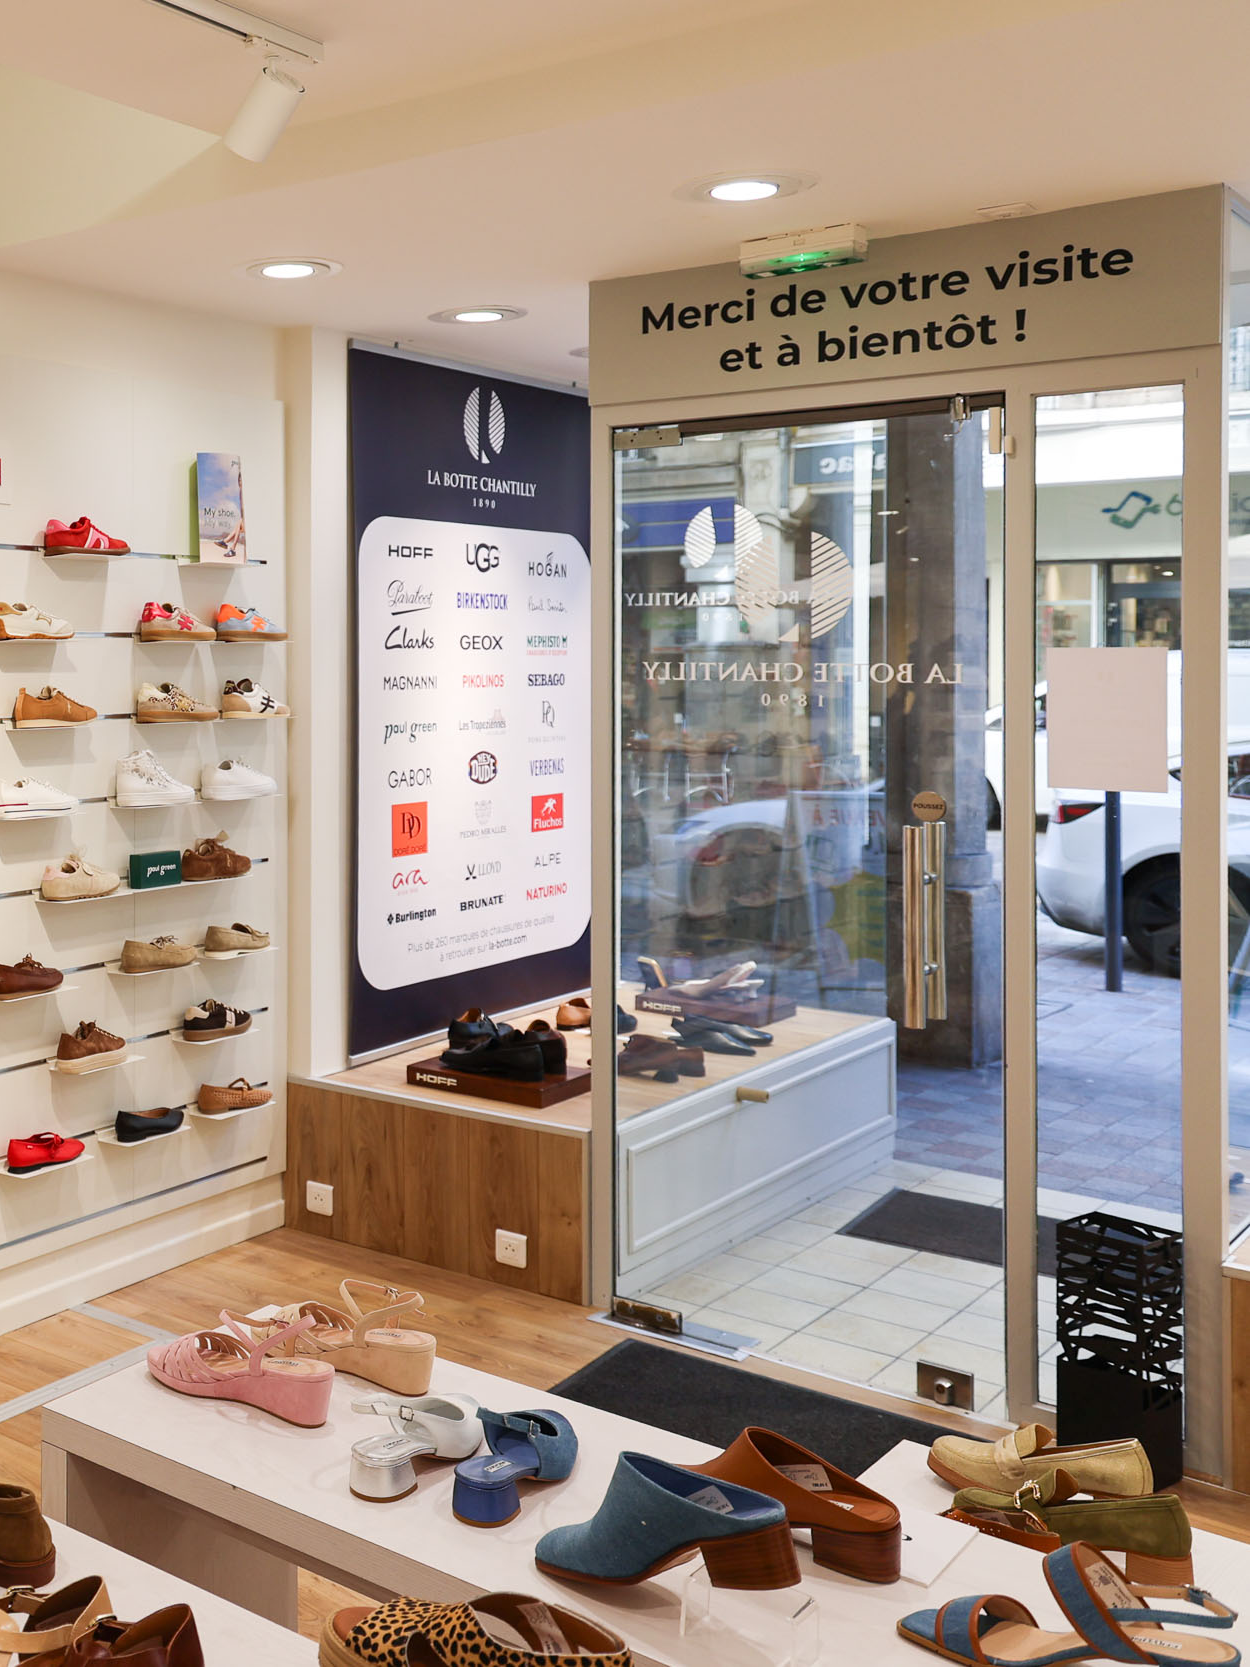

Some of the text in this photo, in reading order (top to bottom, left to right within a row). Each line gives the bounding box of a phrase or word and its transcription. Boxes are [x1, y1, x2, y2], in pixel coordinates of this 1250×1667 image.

[641, 243, 1135, 335] Merci de votre visite
[718, 308, 1029, 373] et à bientôt !
[427, 469, 537, 497] LA BOTTE CHANTILLY
[472, 497, 496, 509] 1890
[203, 506, 216, 519] My
[388, 544, 434, 559] HOFF
[465, 543, 500, 573] UGG
[527, 560, 568, 578] HOGAN
[456, 591, 510, 610] BIRKENSTOCK
[384, 624, 435, 650] Clarks
[459, 634, 503, 650] GEOX
[526, 633, 561, 649] MEPHISTO
[383, 675, 438, 691] MAGNANNI
[461, 673, 506, 689] PIKOLINOS
[527, 673, 566, 687] SEBAGO
[383, 721, 438, 745] paul green
[529, 757, 565, 777] VERBENAS
[388, 768, 433, 788] GABOR
[913, 803, 944, 811] POUSSEZ
[533, 817, 563, 829] Fluchos
[534, 852, 562, 868] ALPE
[147, 863, 177, 878] paul green
[478, 861, 502, 877] LLOYD
[392, 869, 429, 889] ara
[526, 882, 568, 902] NATURINO
[460, 894, 503, 912] BRUNATE
[395, 908, 437, 924] Burlington
[643, 1001, 682, 1013] HOFF
[416, 1072, 457, 1087] HOFF
